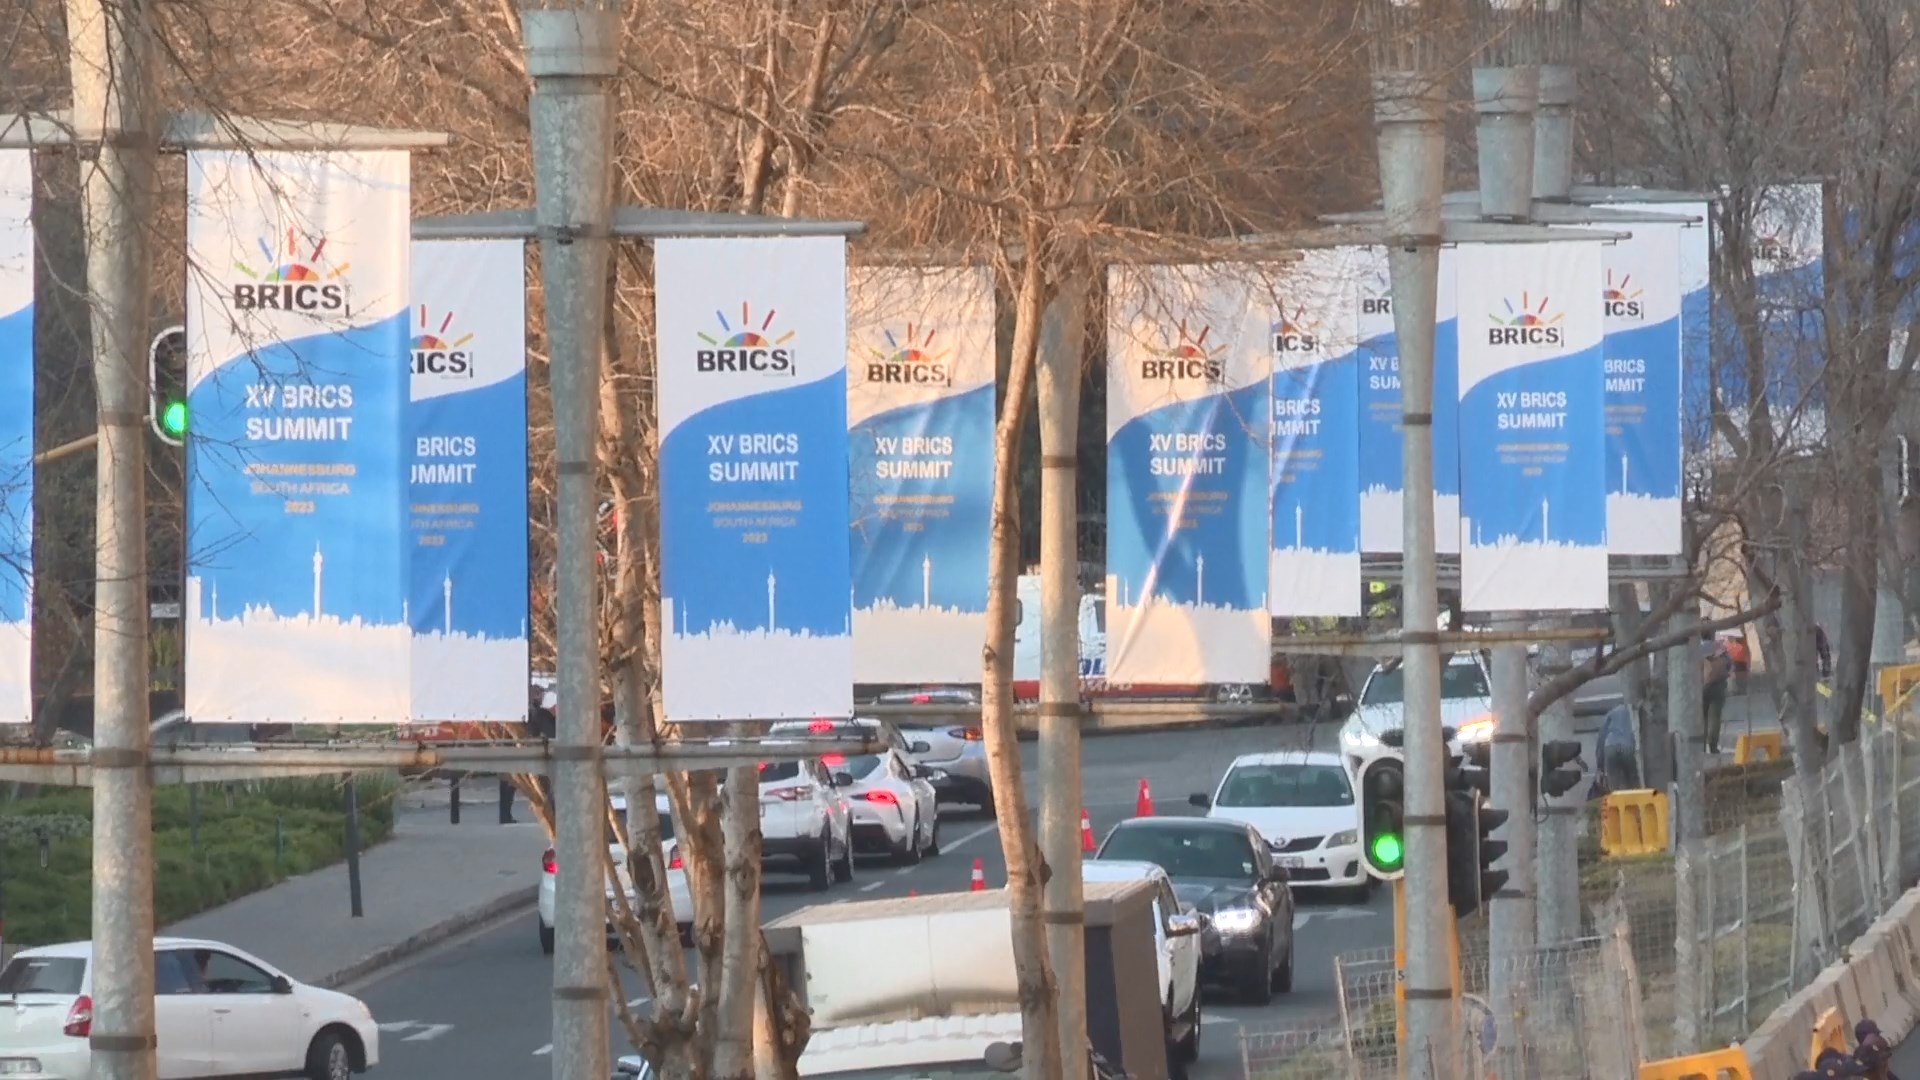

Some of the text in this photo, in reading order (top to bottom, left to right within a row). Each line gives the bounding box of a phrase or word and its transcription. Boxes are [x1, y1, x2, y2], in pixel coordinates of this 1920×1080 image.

[234, 284, 342, 310] BRICS
[1605, 302, 1640, 316] ICS
[1276, 335, 1314, 351] ICS
[1489, 328, 1559, 345] BRICS
[410, 351, 467, 373] ICS
[697, 350, 789, 371] BRICS
[1142, 360, 1221, 379] BRICS
[1369, 357, 1388, 371] XV
[1604, 359, 1645, 374] BRICS
[867, 364, 945, 383] BRICS
[1605, 378, 1645, 392] MMIT
[245, 384, 352, 408] XV BRICS
[1497, 391, 1567, 408] XV BRICS
[1276, 399, 1321, 416] BRICS
[246, 416, 352, 440] SUMMIT
[1273, 420, 1321, 436] MMIT
[1497, 413, 1567, 429] SUMMIT
[416, 436, 476, 456] BRICS
[708, 433, 799, 455] XV BRICS
[875, 436, 953, 456] XV BRICS
[1150, 433, 1226, 452] XV BRICS
[410, 463, 476, 484] MMIT
[709, 461, 799, 482] SUMMIT
[875, 460, 952, 479] SUMMIT
[1150, 457, 1226, 476] SUMMIT
